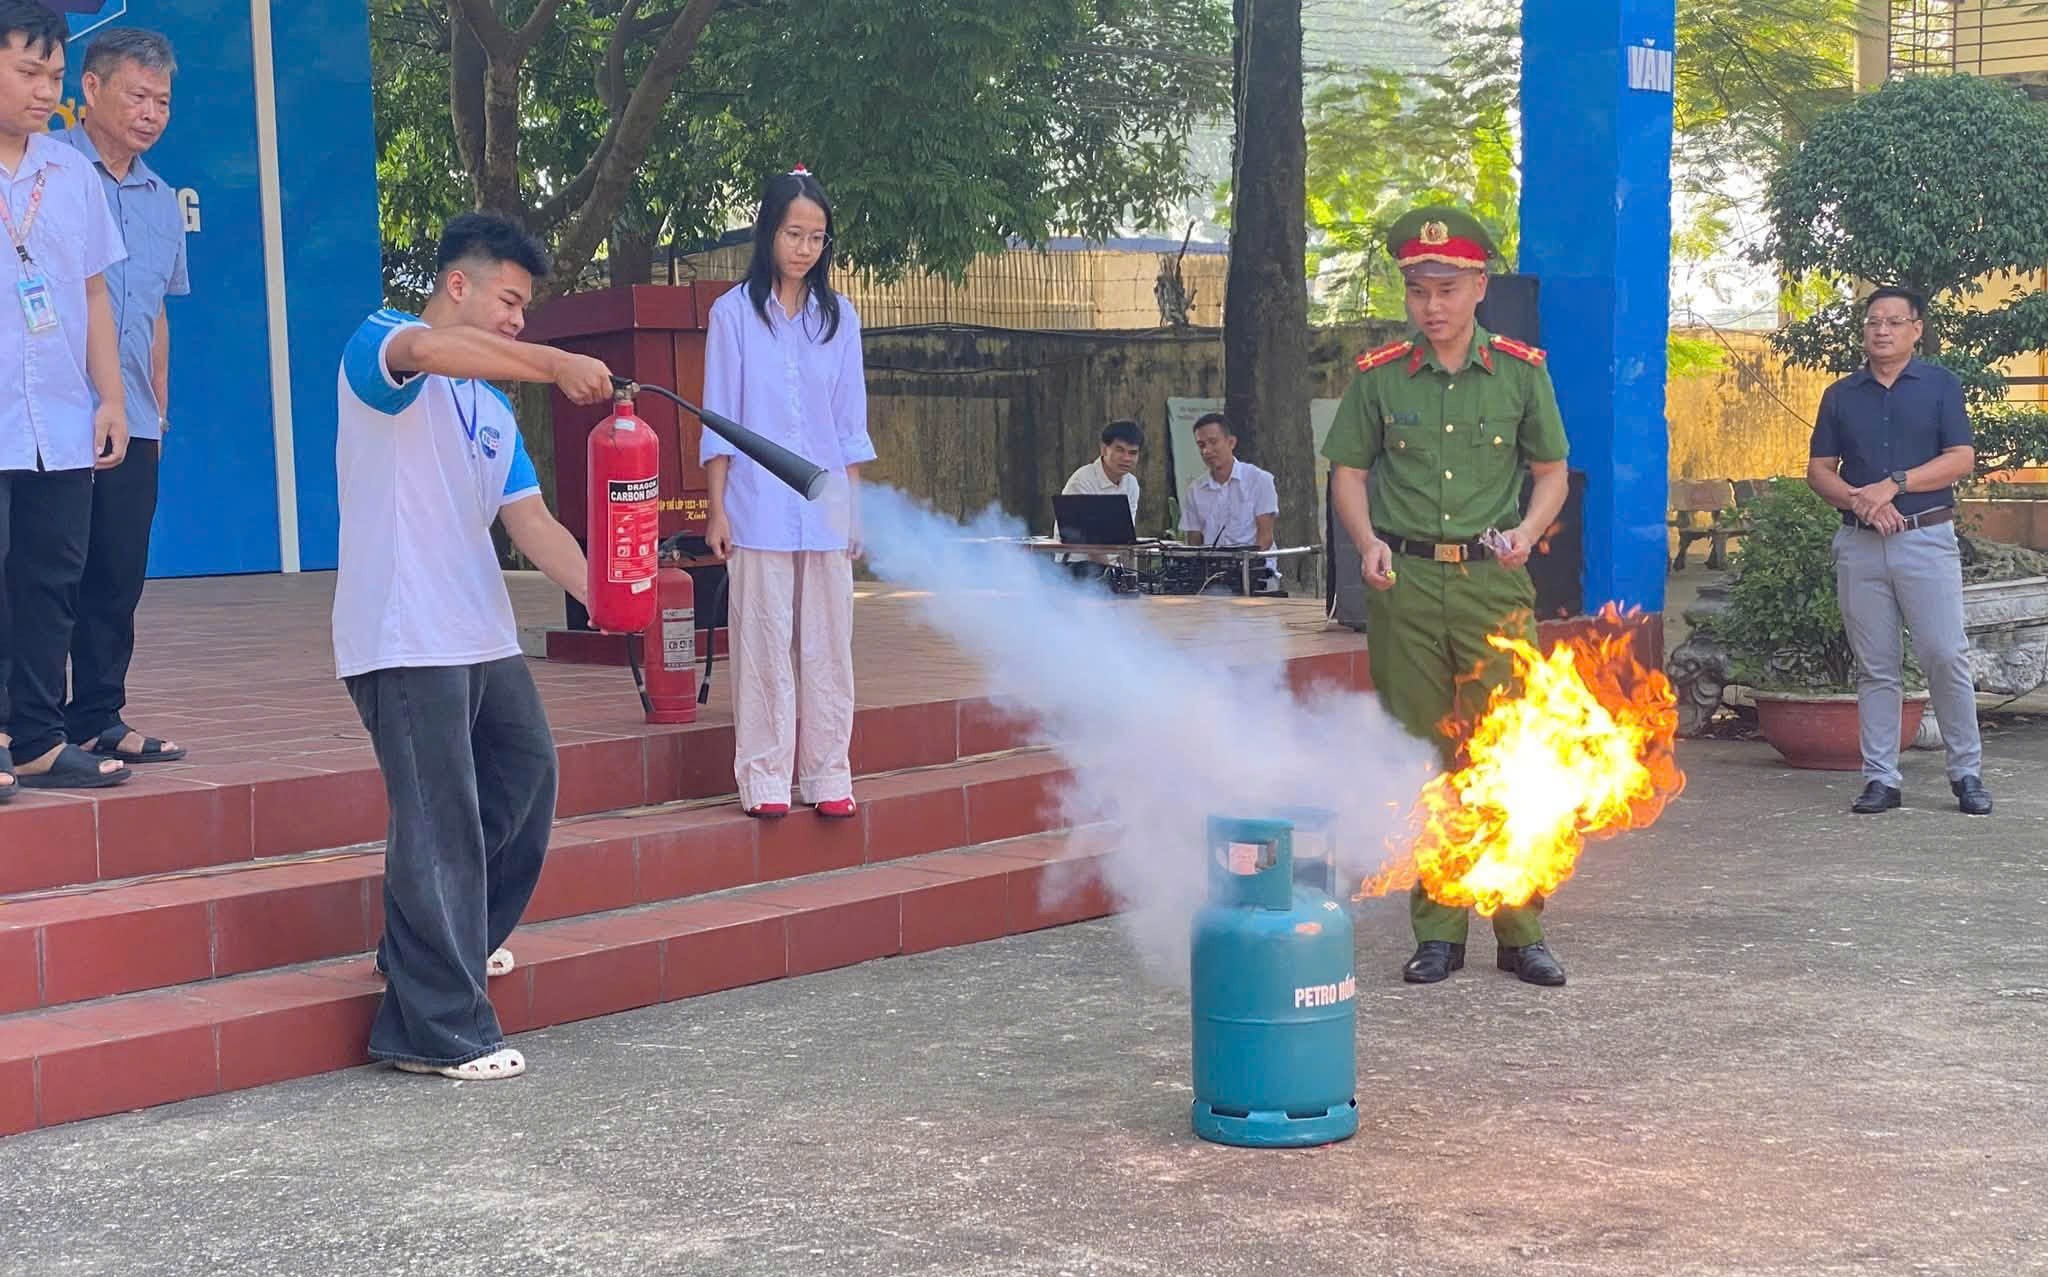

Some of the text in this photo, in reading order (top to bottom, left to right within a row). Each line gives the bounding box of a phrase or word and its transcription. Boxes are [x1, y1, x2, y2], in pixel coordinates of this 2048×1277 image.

[627, 480, 657, 491] DRAGON
[611, 491, 645, 502] CARBON
[1295, 983, 1337, 1008] PETRO
